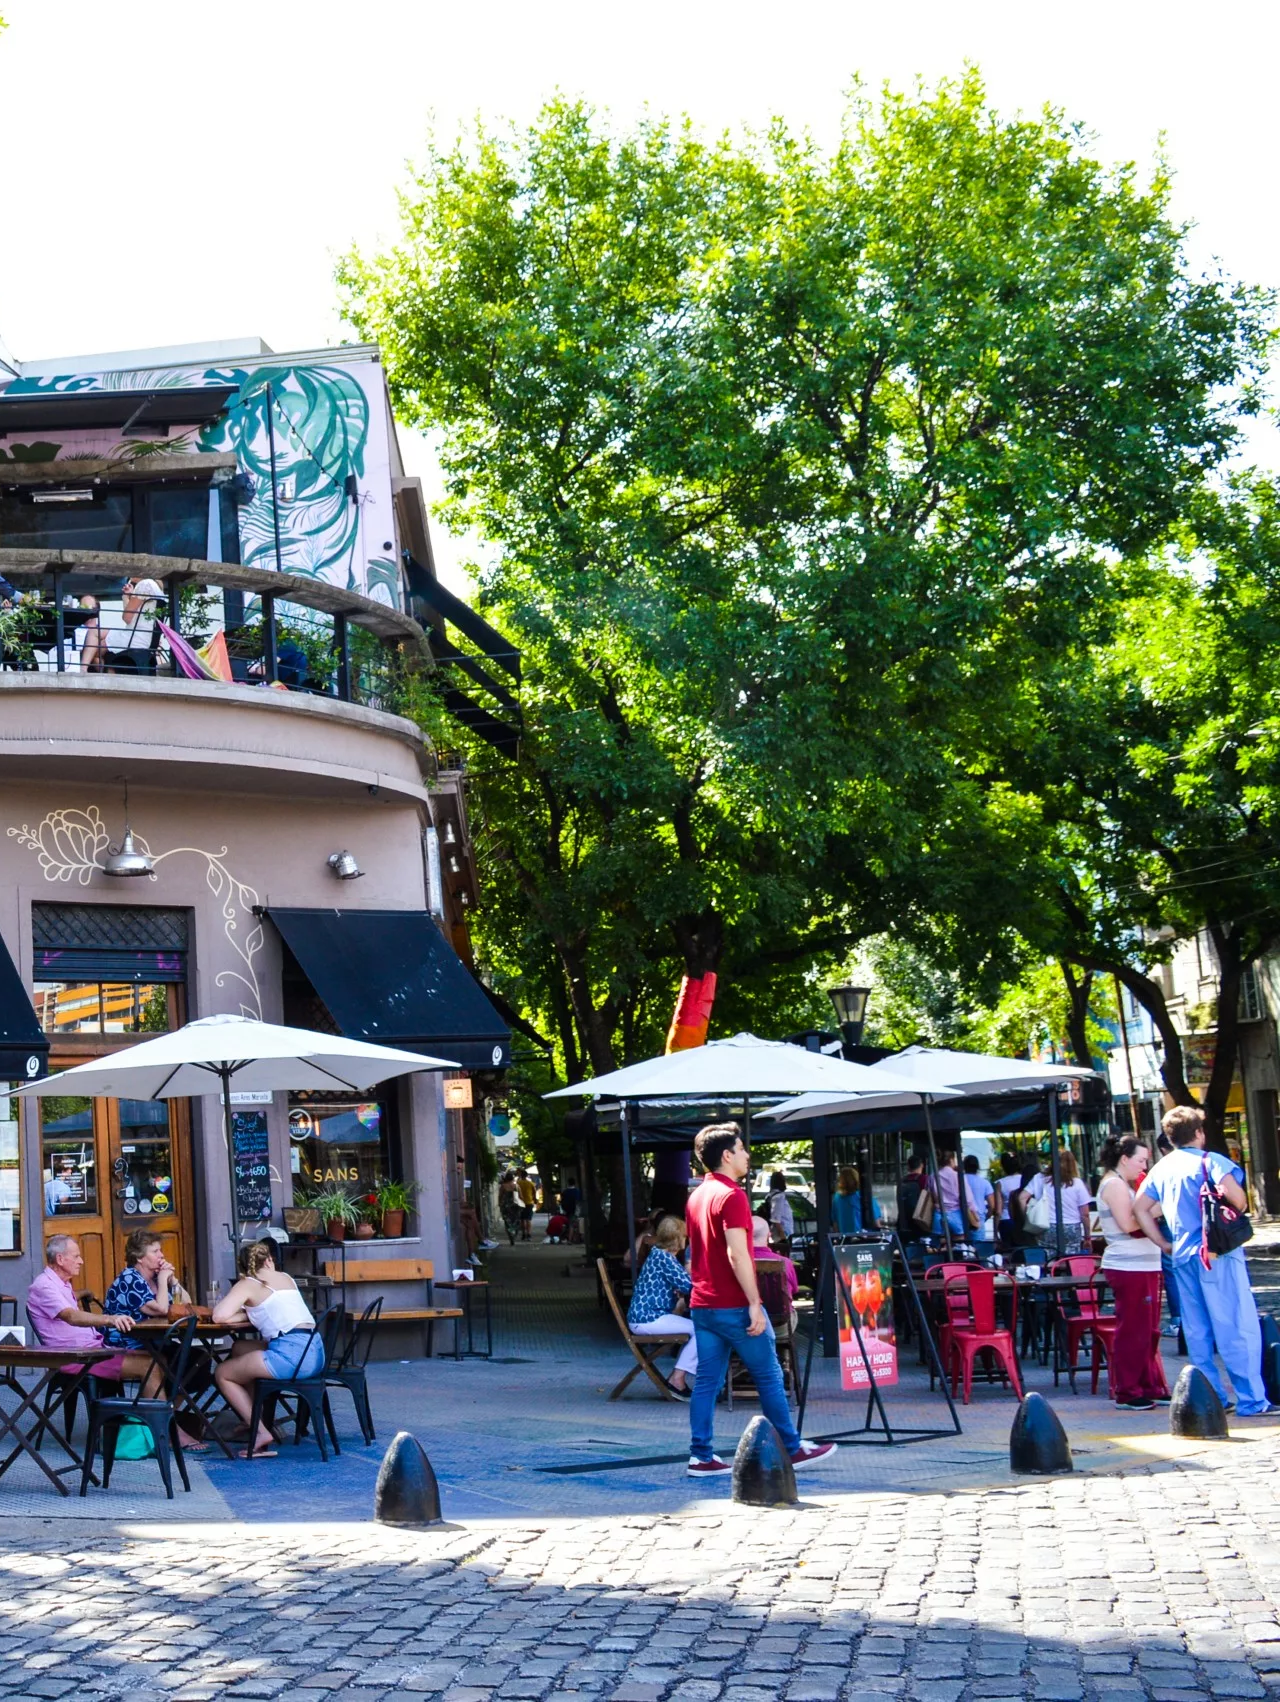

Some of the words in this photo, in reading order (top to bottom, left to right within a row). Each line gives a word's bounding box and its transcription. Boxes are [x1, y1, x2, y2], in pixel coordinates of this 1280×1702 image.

[313, 1167, 359, 1183] SANS
[856, 1253, 873, 1263] SANS
[873, 1352, 893, 1364] HOUR
